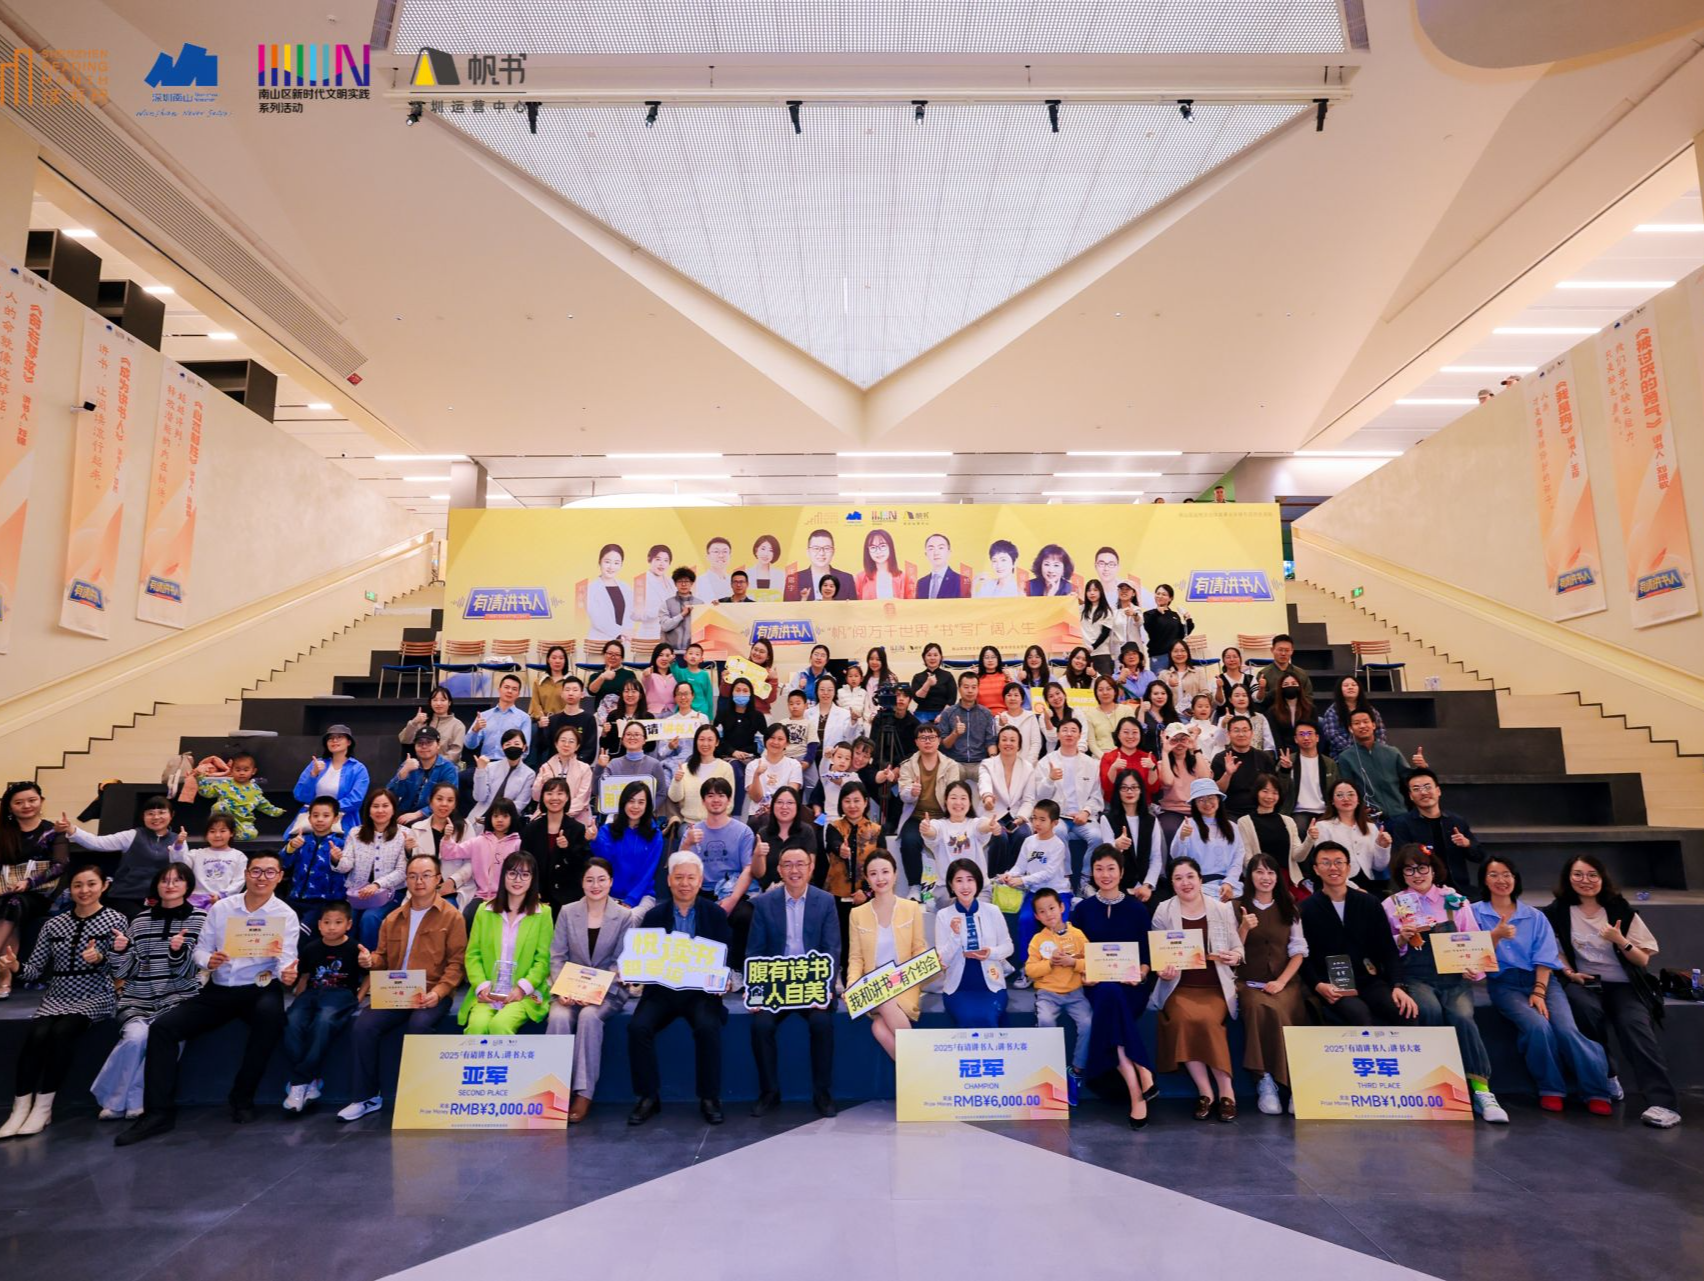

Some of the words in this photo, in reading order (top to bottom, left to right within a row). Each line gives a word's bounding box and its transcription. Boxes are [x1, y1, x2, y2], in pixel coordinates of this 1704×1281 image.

[1636, 327, 1663, 429] 《被讨厌的勇气》
[1195, 576, 1267, 594] 有请讲书人
[473, 593, 545, 611] 有请讲书人
[756, 624, 812, 640] 有请讲书人
[748, 958, 829, 983] 腹有诗书
[765, 980, 825, 1005] 人自美
[848, 973, 893, 1012] 我和讲书
[899, 955, 938, 987] 有个约会
[462, 1066, 508, 1085] 亚军
[959, 1059, 1005, 1078] 冠军
[1352, 1058, 1400, 1077] 季军
[458, 1089, 486, 1097] SECOND
[487, 1089, 508, 1097] PLACE
[954, 1095, 1041, 1108] RMB¥6,000.00
[1351, 1095, 1444, 1109] RMB¥1,000.00
[450, 1102, 543, 1117] RMB¥3,000.00
